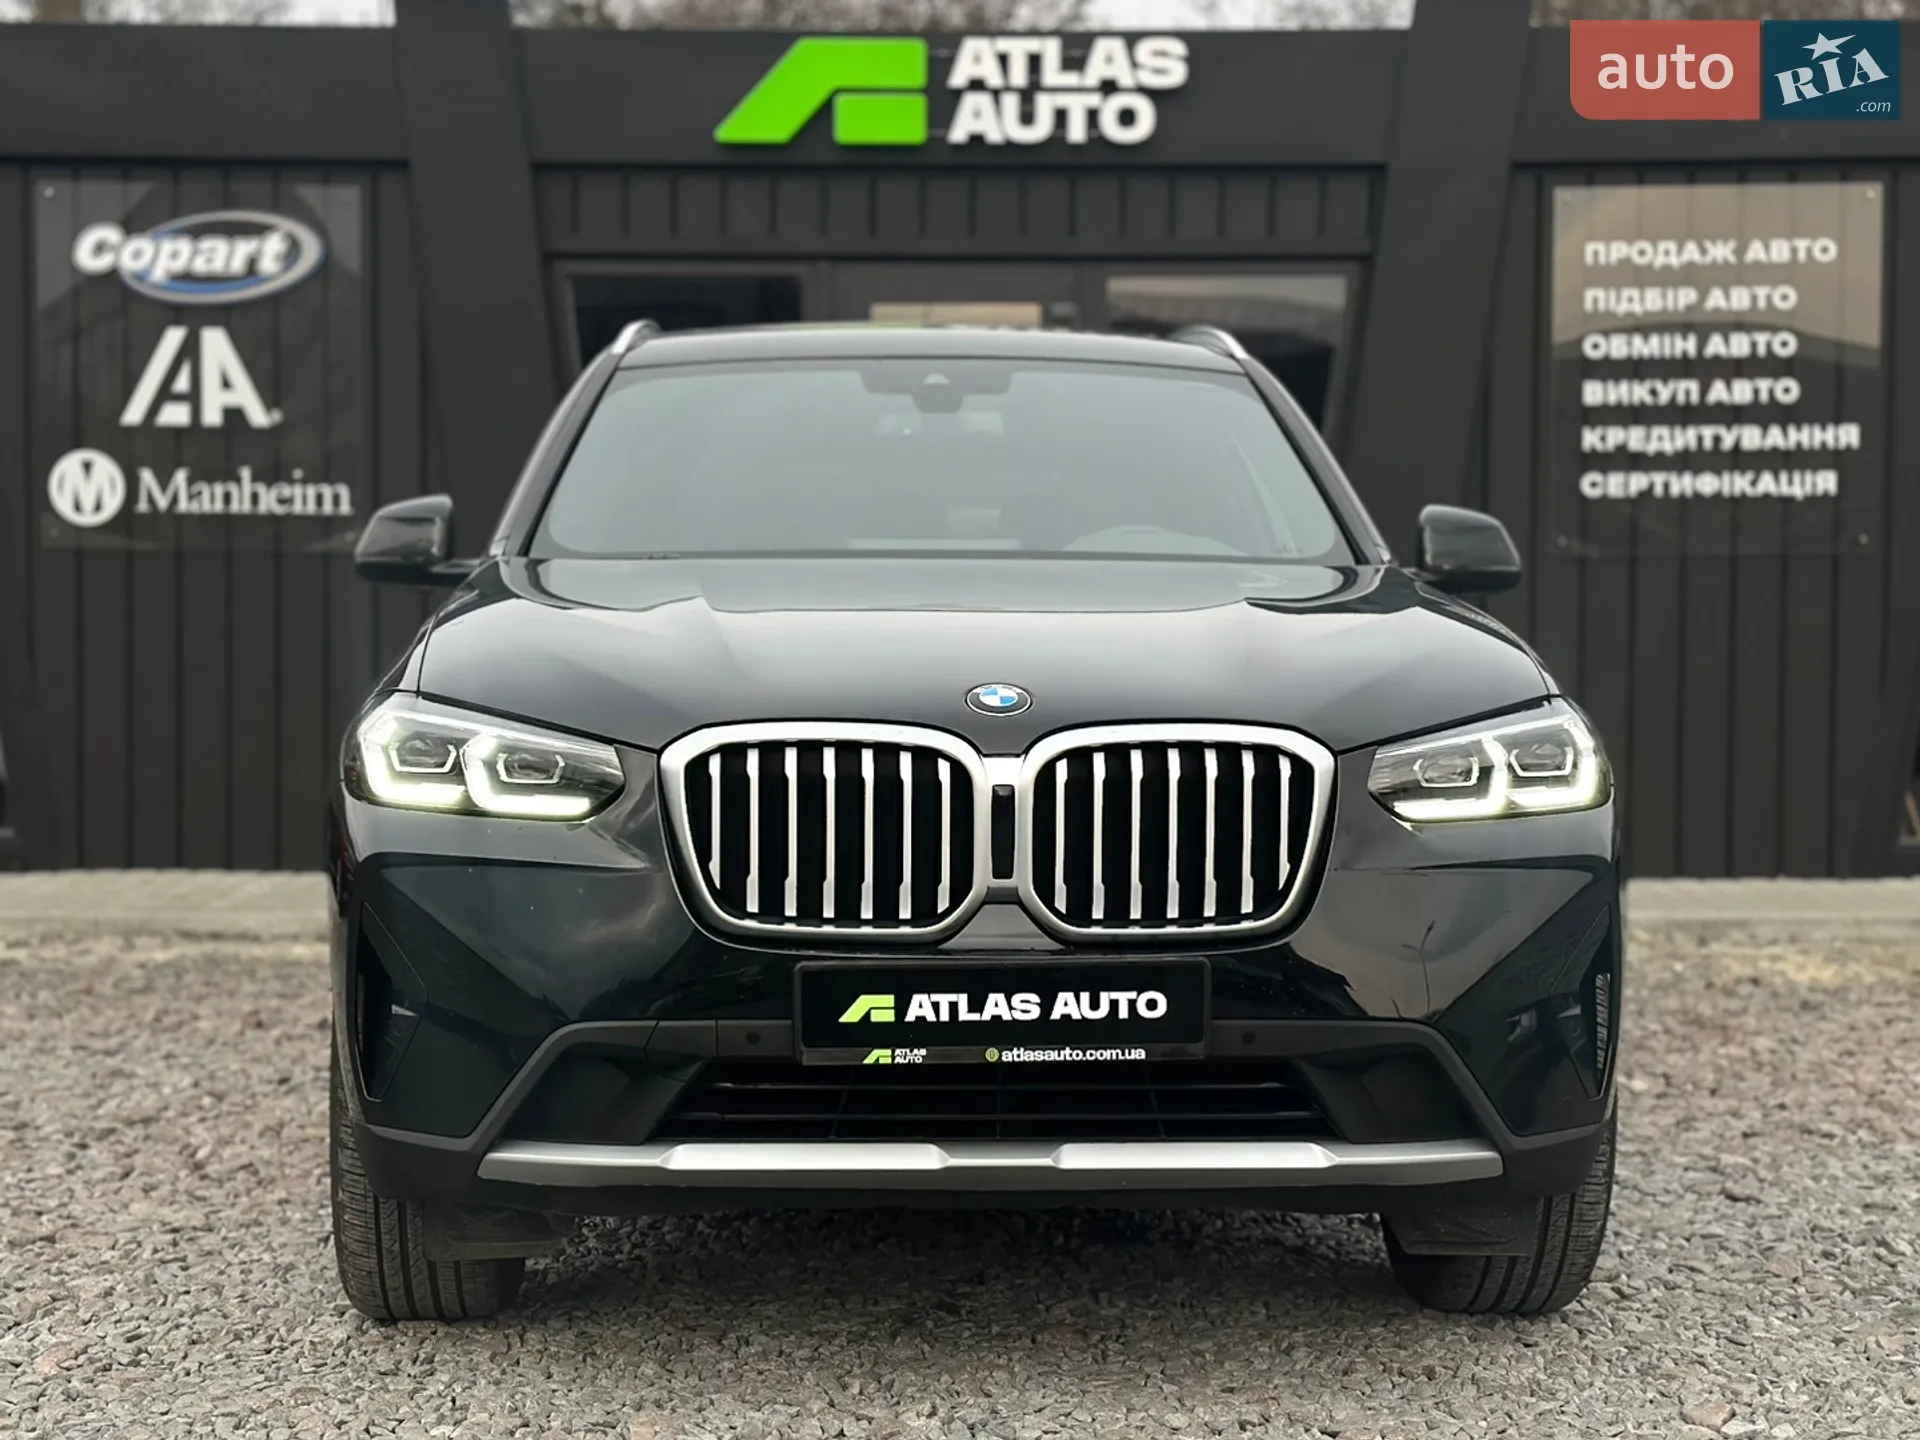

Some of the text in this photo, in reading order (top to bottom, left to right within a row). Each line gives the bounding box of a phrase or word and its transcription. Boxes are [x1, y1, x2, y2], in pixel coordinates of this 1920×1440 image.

[948, 36, 1190, 89] ATLAS
[947, 91, 1158, 145] AUTO
[73, 221, 291, 284] Copart
[1583, 237, 1839, 270] ПРОДАЖ АВТО
[1583, 285, 1799, 316] ПІДБІР АВТО
[1581, 331, 1798, 360] ОБМІН АВТО
[1581, 376, 1801, 407] ВИКУП АВТО
[1581, 422, 1861, 456] КРЕДИТУВАННЯ
[135, 466, 354, 516] Manheim
[1579, 469, 1839, 501] СЕРТИФІКАЦІЯ
[904, 990, 1168, 1022] ATLAS AUTO
[1001, 1046, 1146, 1062] atlasauto.com.ua
